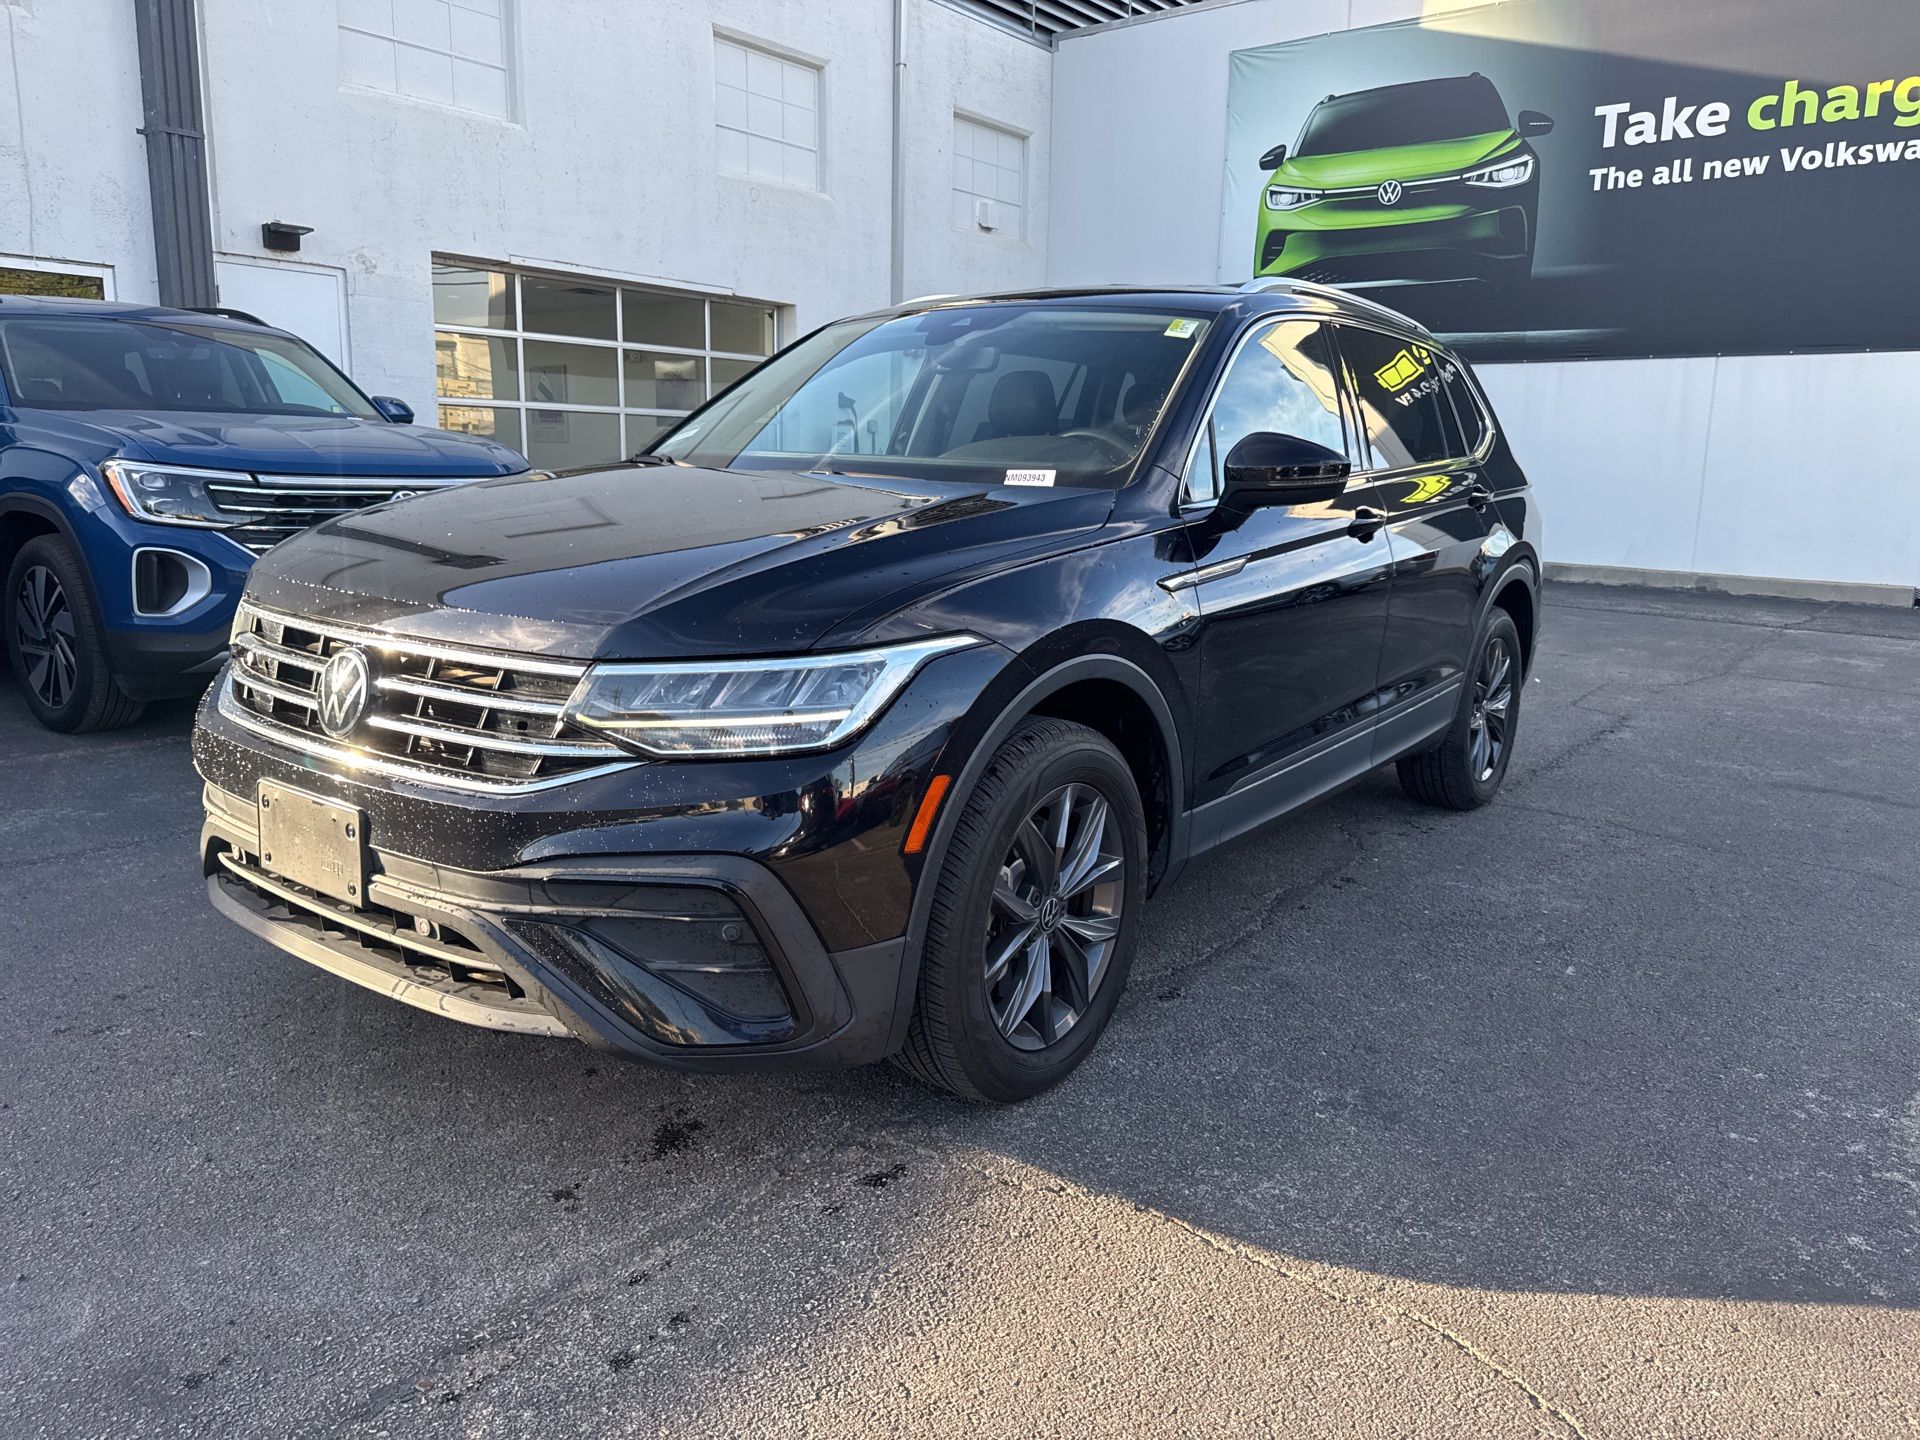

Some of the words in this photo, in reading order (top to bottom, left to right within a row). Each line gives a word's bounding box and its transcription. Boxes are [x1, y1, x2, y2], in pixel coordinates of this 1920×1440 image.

[1594, 96, 1730, 148] Take
[1747, 76, 1920, 130] charg
[1378, 180, 1402, 205] VW
[1589, 166, 1643, 191] The
[1652, 158, 1693, 186] all
[1702, 155, 1771, 180] new
[319, 649, 368, 734] VW
